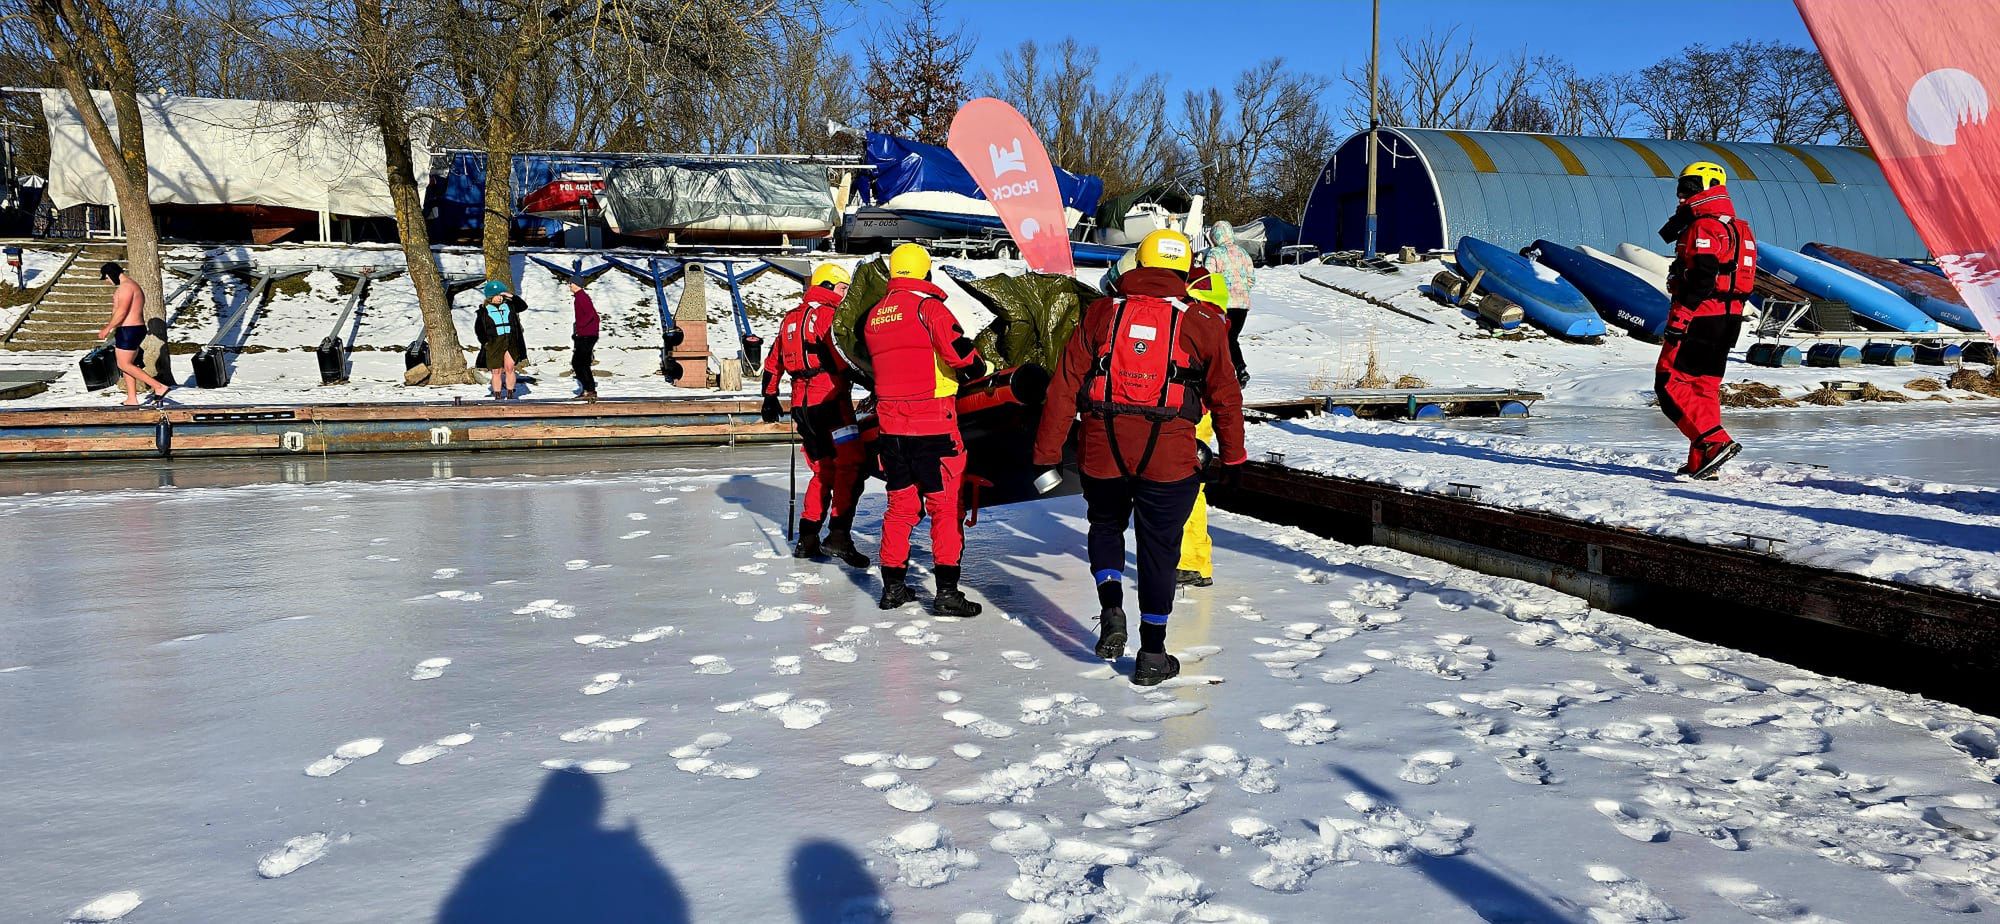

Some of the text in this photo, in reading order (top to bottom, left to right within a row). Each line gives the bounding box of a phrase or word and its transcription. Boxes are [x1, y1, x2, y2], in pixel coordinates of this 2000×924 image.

[559, 183, 574, 192] POL
[877, 305, 899, 316] SURF
[870, 313, 903, 326] RESCUE
